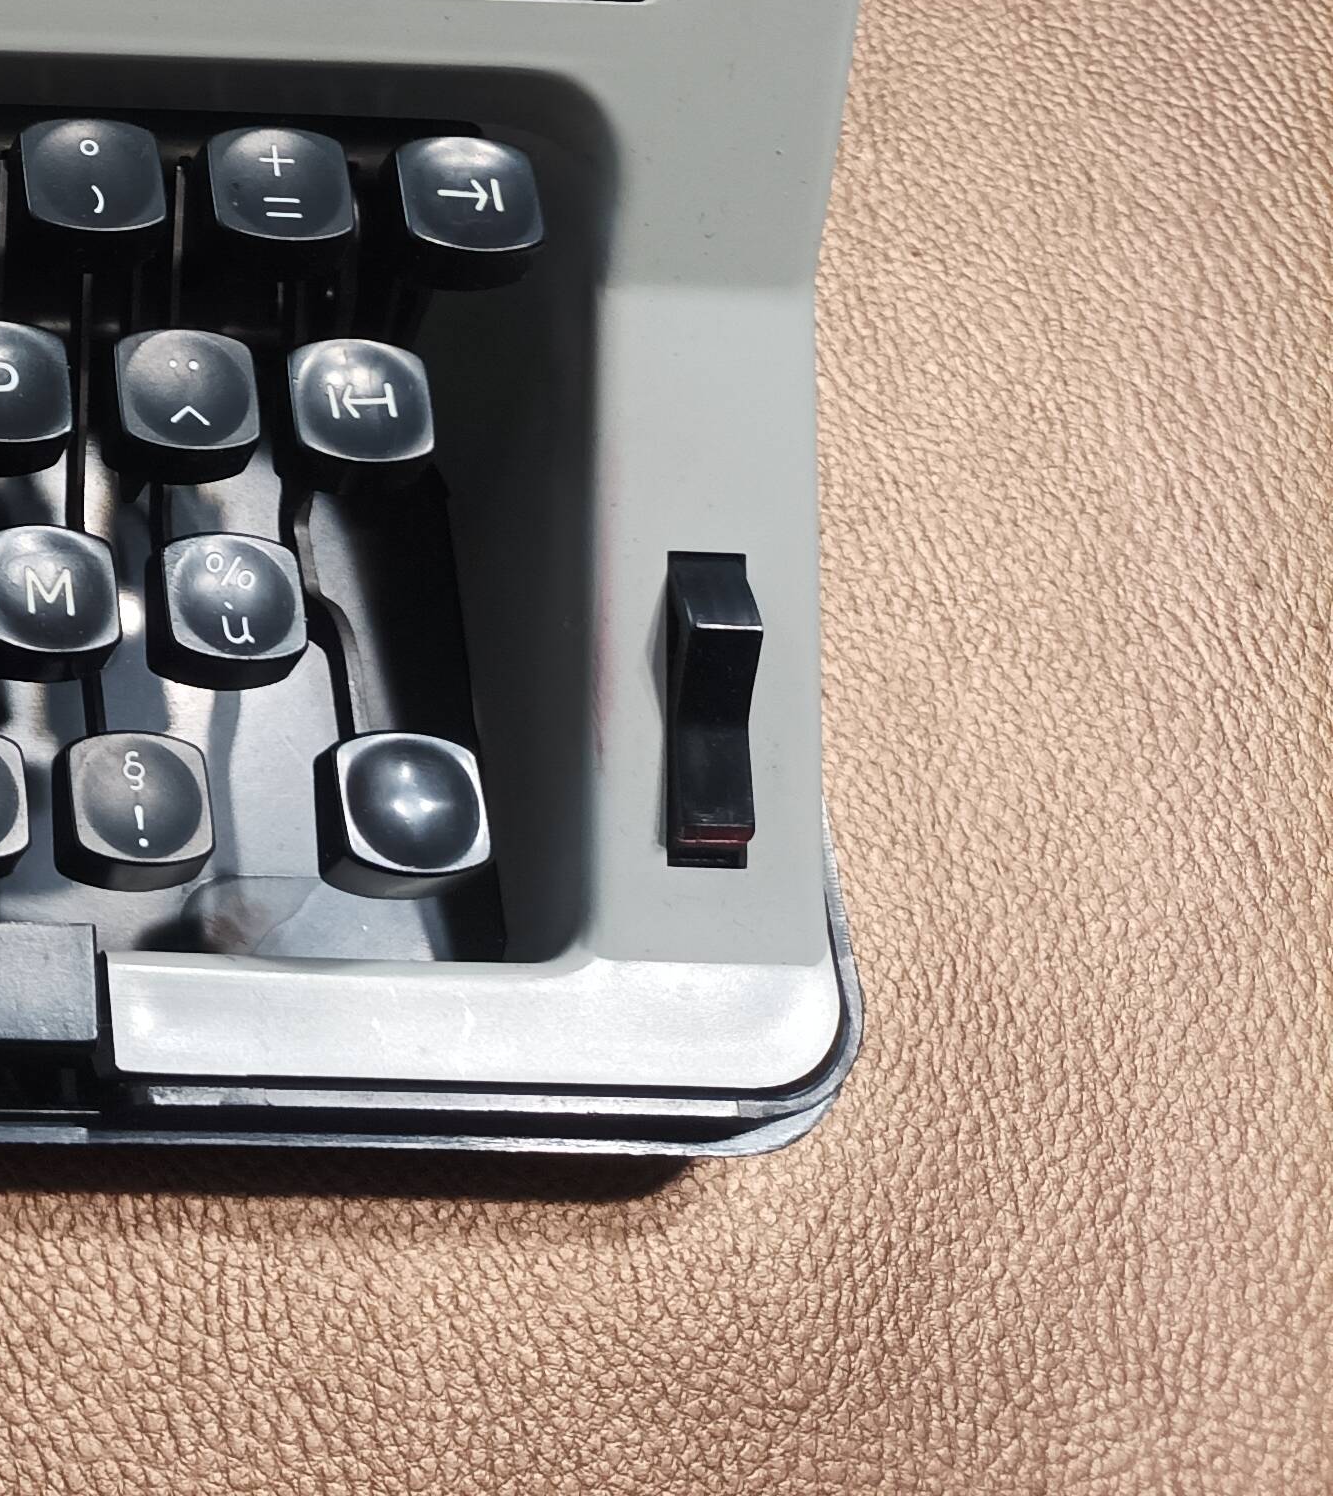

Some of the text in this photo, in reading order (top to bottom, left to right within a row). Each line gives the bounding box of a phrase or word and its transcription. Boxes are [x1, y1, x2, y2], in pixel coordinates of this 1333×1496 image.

[258, 144, 295, 177] +
[91, 184, 105, 214] )
[205, 551, 256, 591] %
[24, 566, 77, 618] M
[220, 601, 256, 645] ù
[122, 750, 146, 791] §
[133, 804, 149, 848] !
